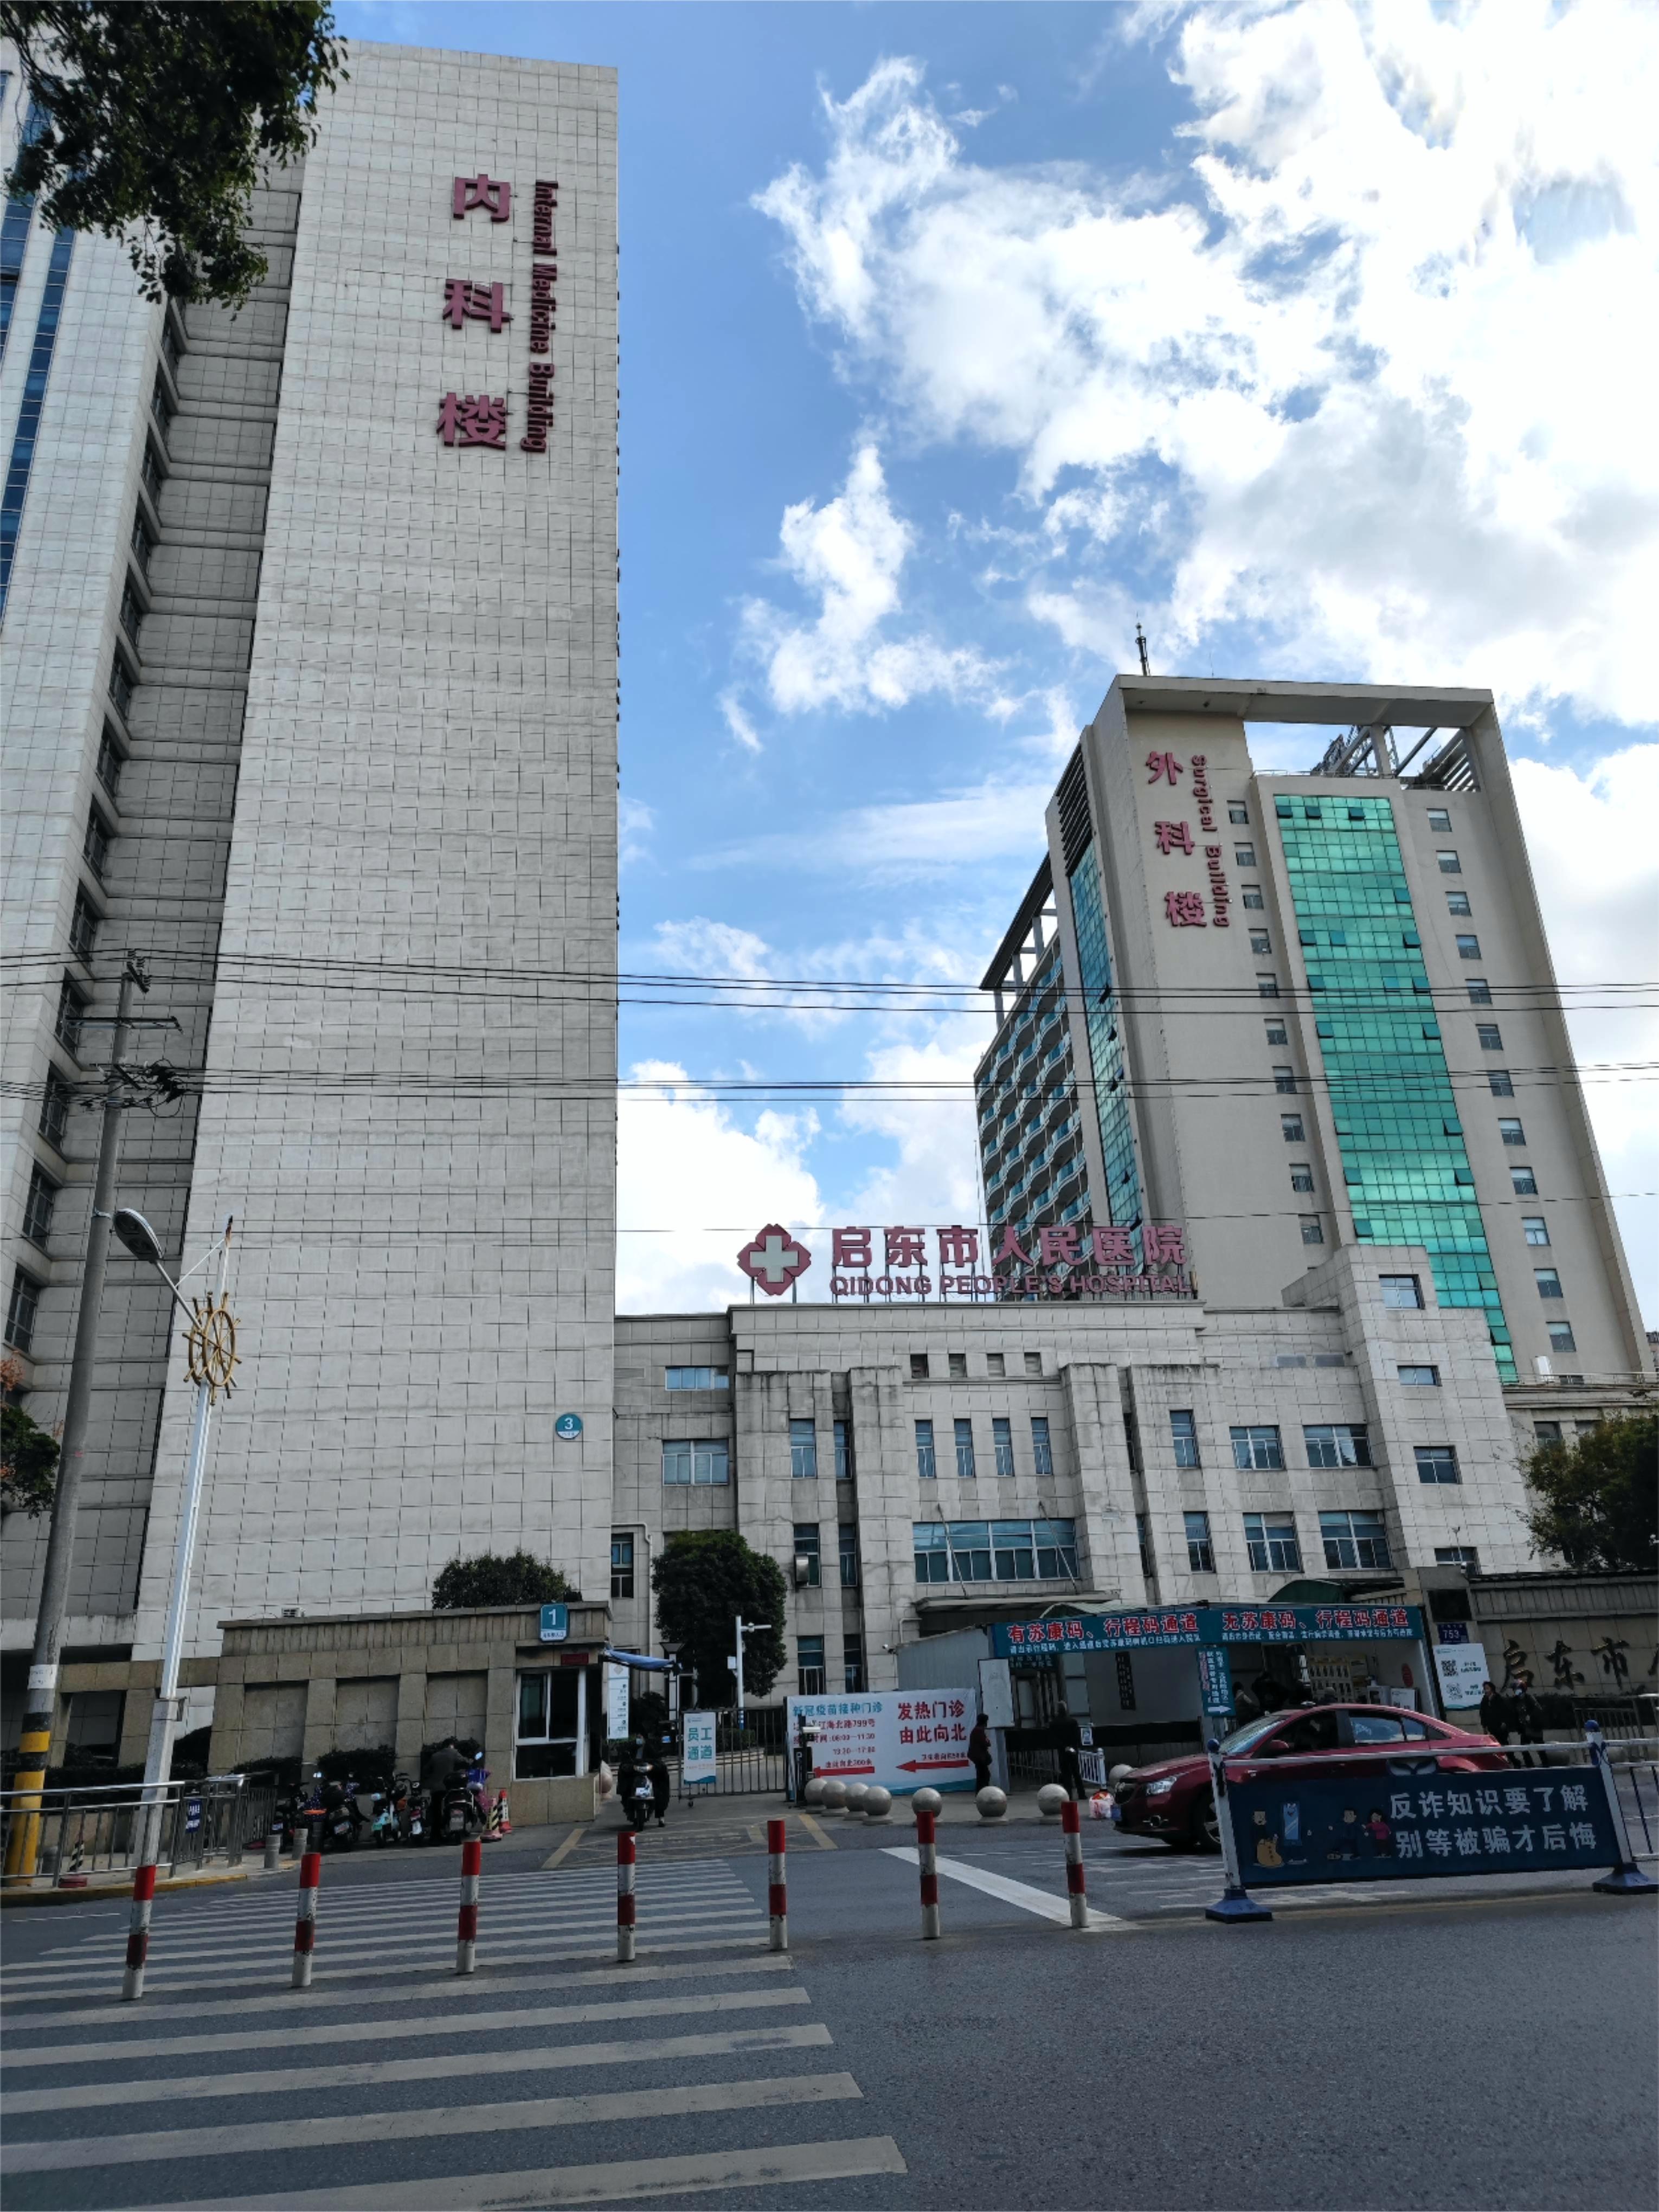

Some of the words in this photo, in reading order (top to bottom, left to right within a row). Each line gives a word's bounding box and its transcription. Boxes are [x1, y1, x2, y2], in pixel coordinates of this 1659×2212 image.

[532, 179, 559, 256] Internal
[436, 173, 511, 450] 内科楼
[529, 263, 557, 354] Medicine
[520, 362, 555, 453] Building
[1145, 751, 1207, 927] 外科楼
[1192, 755, 1218, 832] Surgical
[1205, 845, 1230, 928] Building
[832, 1225, 1187, 1268] 启东市人民医院
[829, 1275, 932, 1296] QIDONG
[941, 1275, 1064, 1295] PEOPLE'S
[1070, 1274, 1192, 1294] HOSPITAL
[564, 1417, 574, 1430] 3
[548, 1608, 556, 1626] 1
[1007, 1612, 1200, 1644] 有苏康码、行程码通道
[1221, 1607, 1410, 1631] 无苏康码、行程码通道
[1501, 1636, 1659, 1692] 启东市
[793, 1701, 883, 1717] 新冠疫苗接种门诊
[898, 1699, 965, 1721] 发热门诊
[687, 1727, 712, 1742] 员工
[899, 1723, 967, 1745] 由此向北
[687, 1745, 712, 1760] 通道
[1390, 1783, 1590, 1820] 反诈知识要了解
[1395, 1822, 1598, 1859] 别等被骗才后悔
